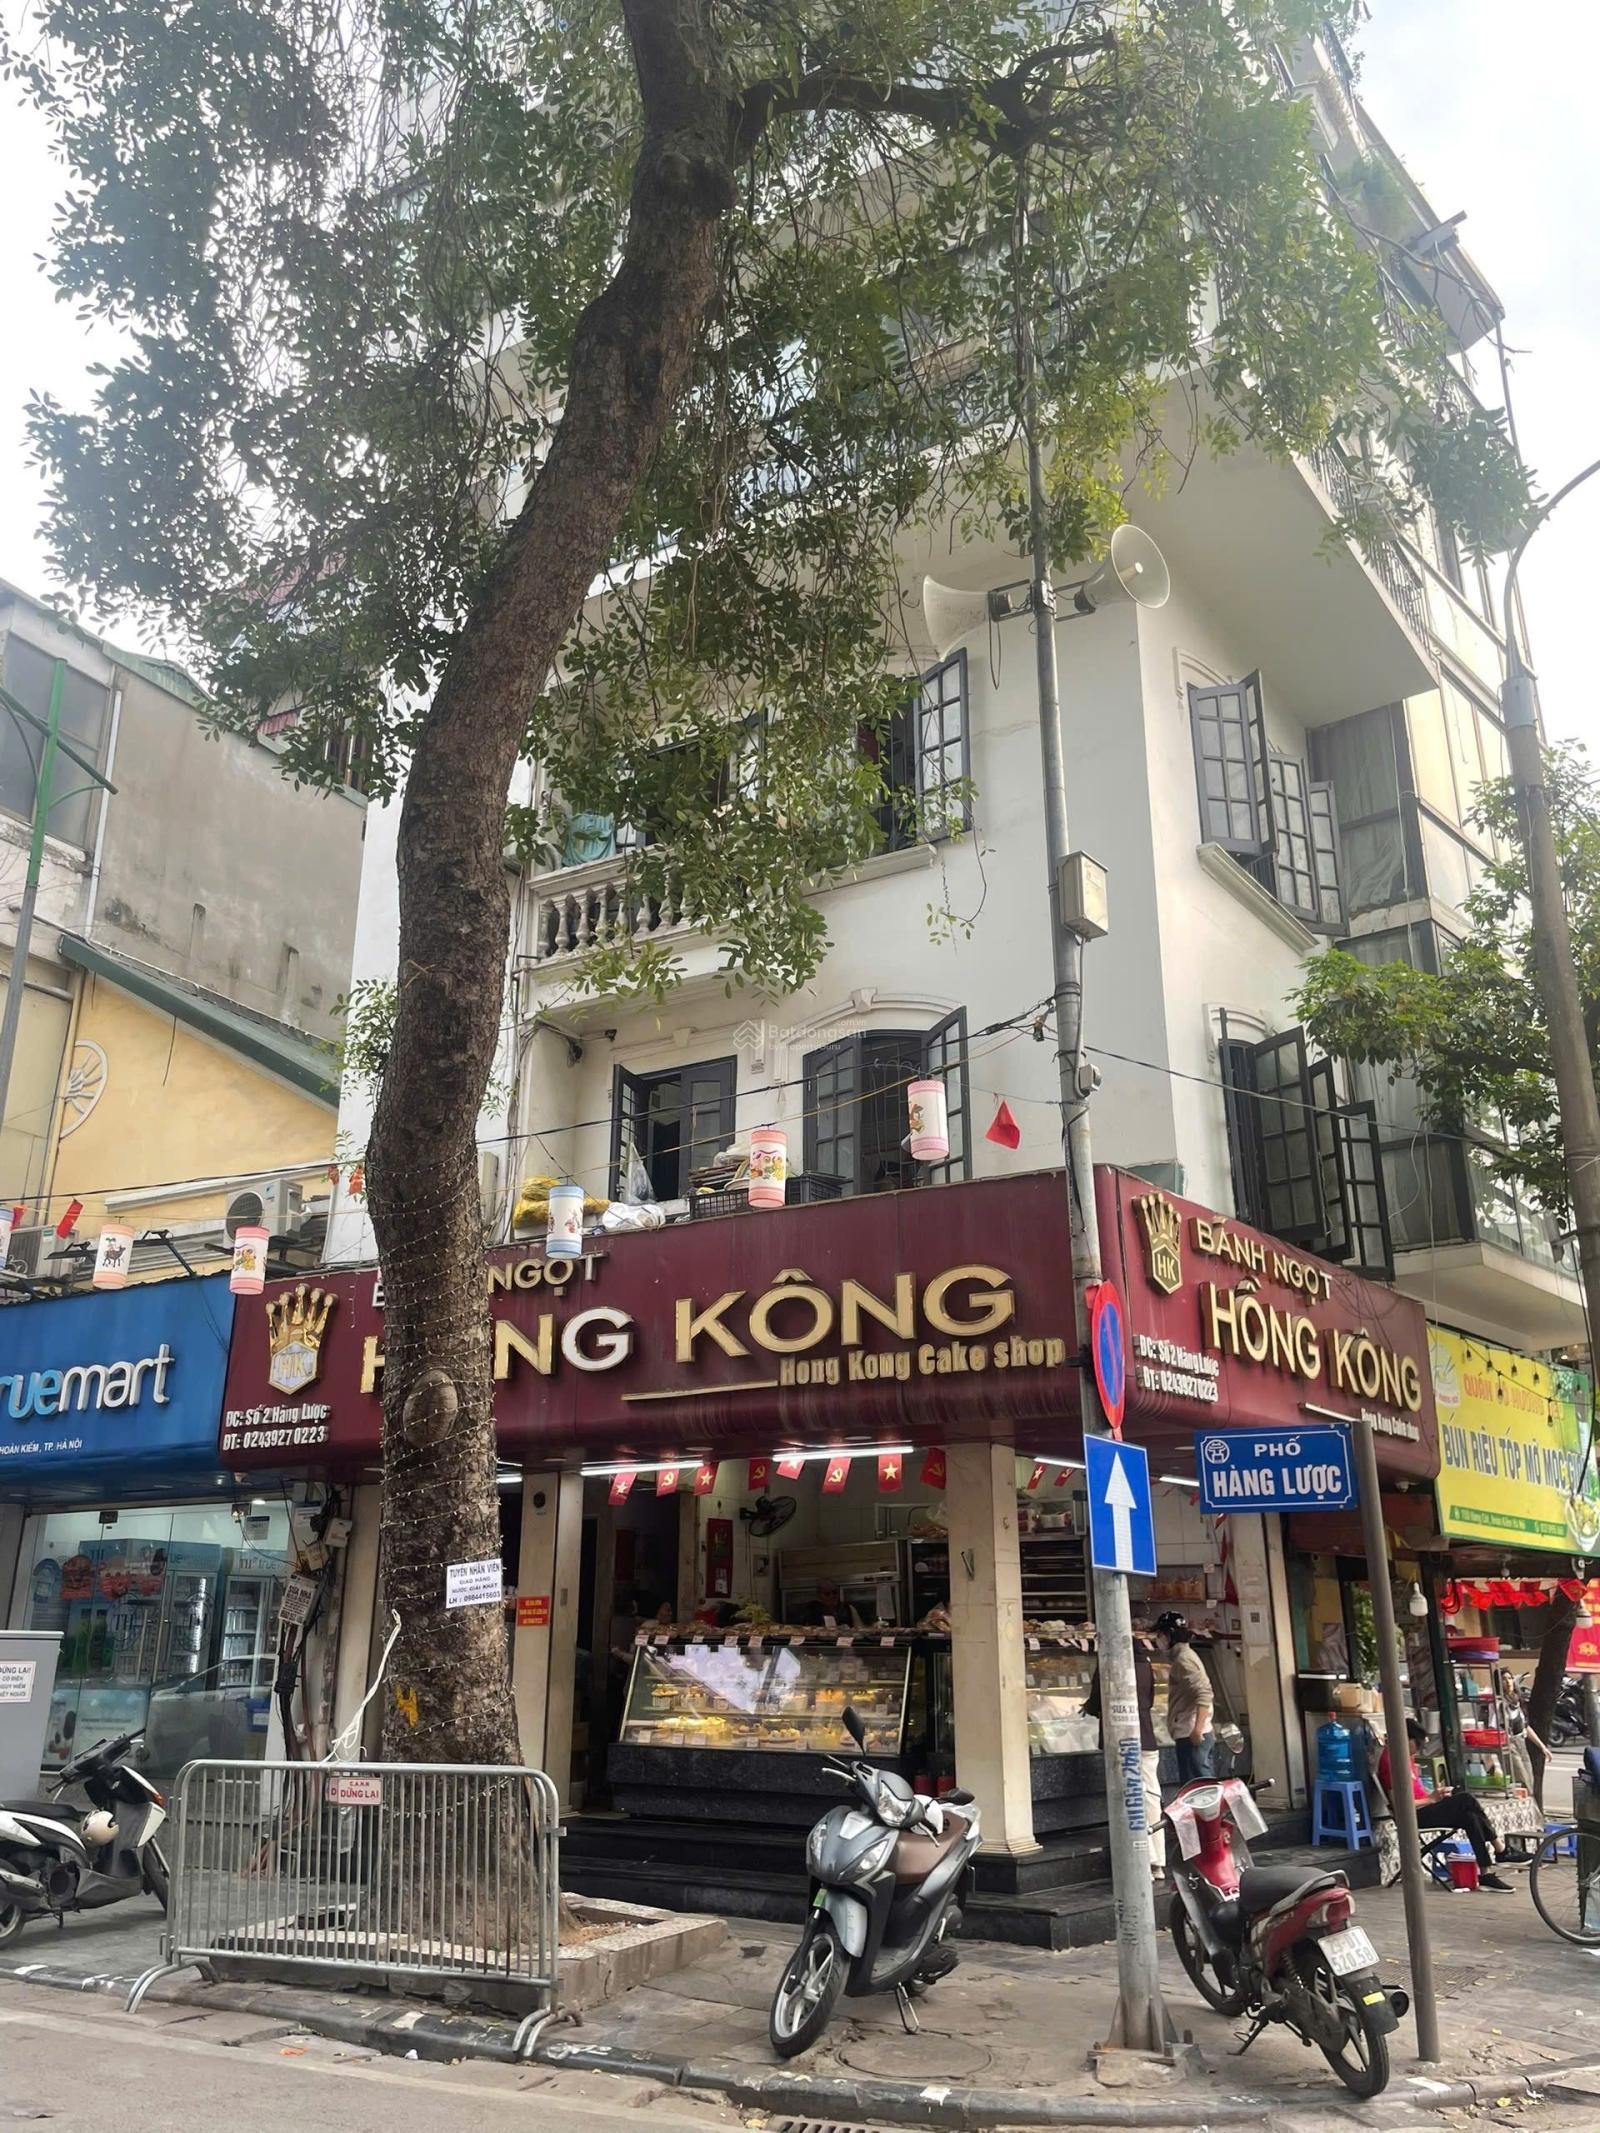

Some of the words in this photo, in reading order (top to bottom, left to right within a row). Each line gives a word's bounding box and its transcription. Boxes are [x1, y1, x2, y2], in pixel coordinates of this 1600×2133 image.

[486, 1251, 609, 1297] NGỌT
[1158, 1254, 1177, 1282] HK
[1192, 1214, 1267, 1275] BÁNH
[1270, 1251, 1333, 1306] NGỌT
[674, 1263, 1016, 1364] KÔNG
[779, 1355, 841, 1387] Hong
[848, 1349, 912, 1381] Kong
[917, 1341, 989, 1375] Cake
[993, 1334, 1067, 1369] shop
[1204, 1275, 1322, 1381] HỒNG
[1328, 1326, 1423, 1413] KÔNG
[261, 1410, 272, 1424] 2
[271, 1404, 299, 1425] Hàng
[300, 1403, 328, 1425] Lược
[56, 1438, 68, 1450] HÀ
[1253, 1435, 1302, 1457] PHỐ
[1212, 1464, 1276, 1498] HÀNG
[1281, 1463, 1342, 1501] LƯỢC
